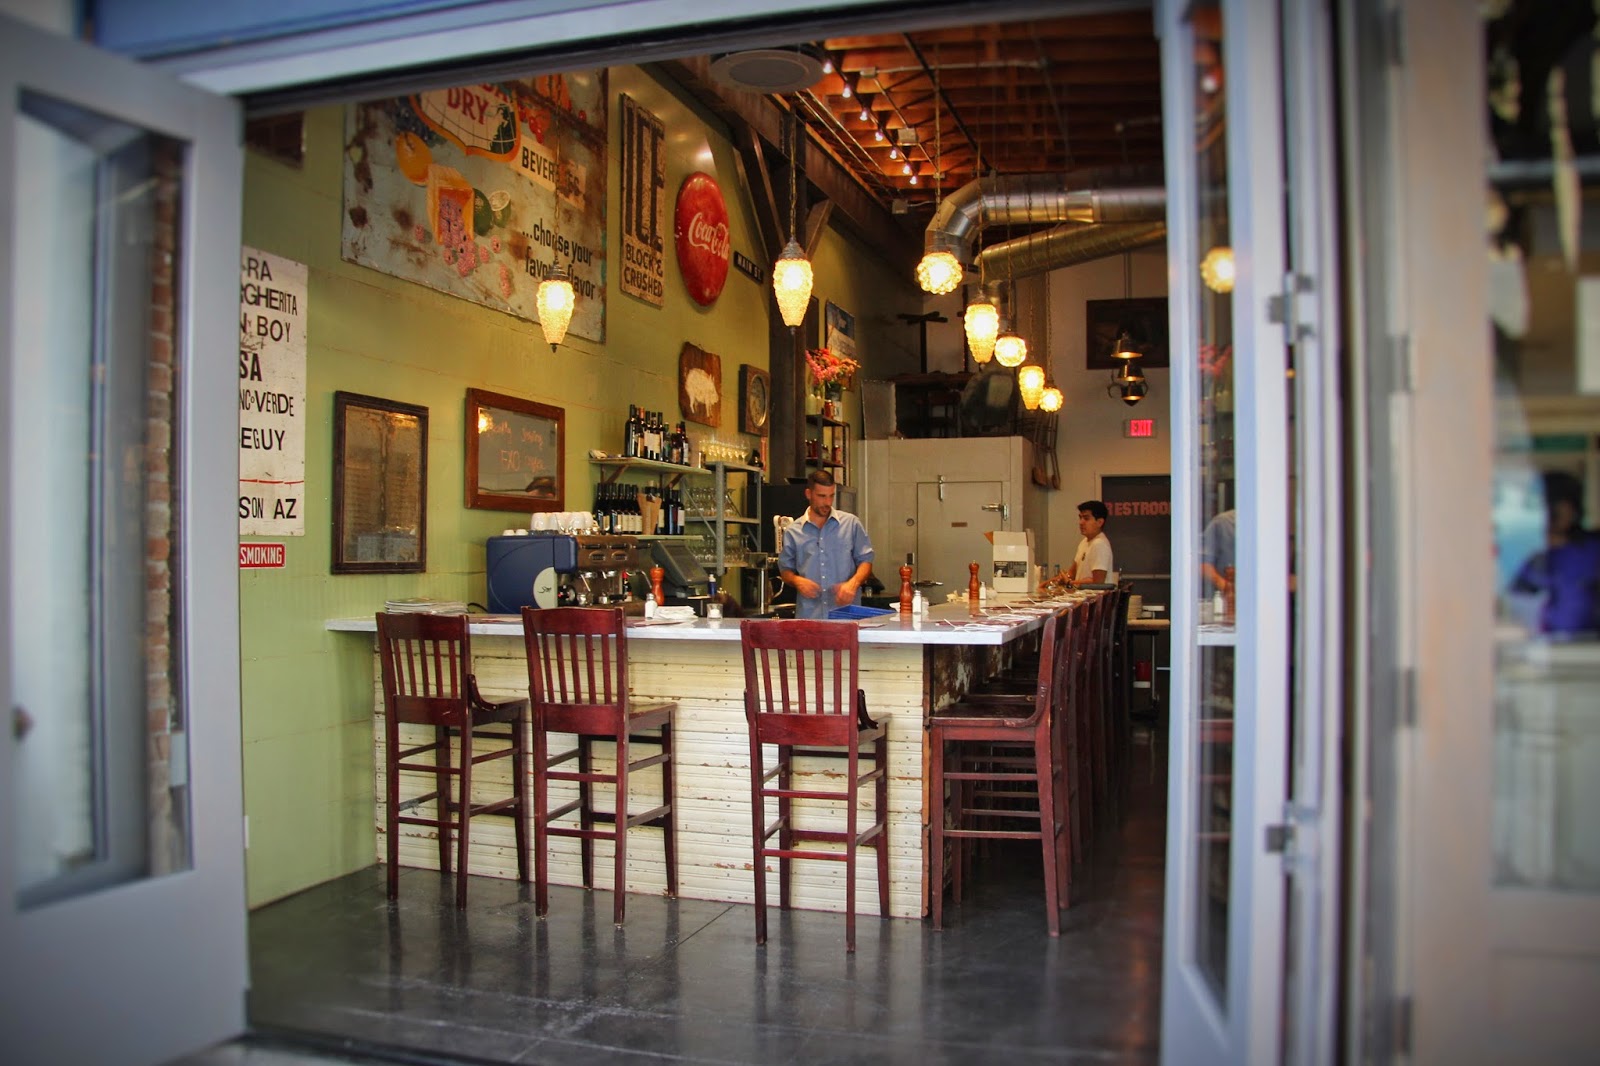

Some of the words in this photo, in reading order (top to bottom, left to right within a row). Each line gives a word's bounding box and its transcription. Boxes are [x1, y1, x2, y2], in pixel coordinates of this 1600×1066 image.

[447, 87, 489, 125] DRY
[522, 146, 581, 197] BEVERES
[625, 106, 665, 253] ICE
[571, 241, 593, 267] your
[626, 243, 656, 274] BLOCK
[656, 259, 664, 277] &
[244, 257, 272, 281] RA
[624, 266, 663, 298] CRUSHED
[257, 315, 291, 343] BOY
[1130, 420, 1153, 436] EXIT
[273, 498, 297, 519] AZ
[1104, 502, 1170, 516] RESTROO
[240, 546, 283, 564] SMOKING
